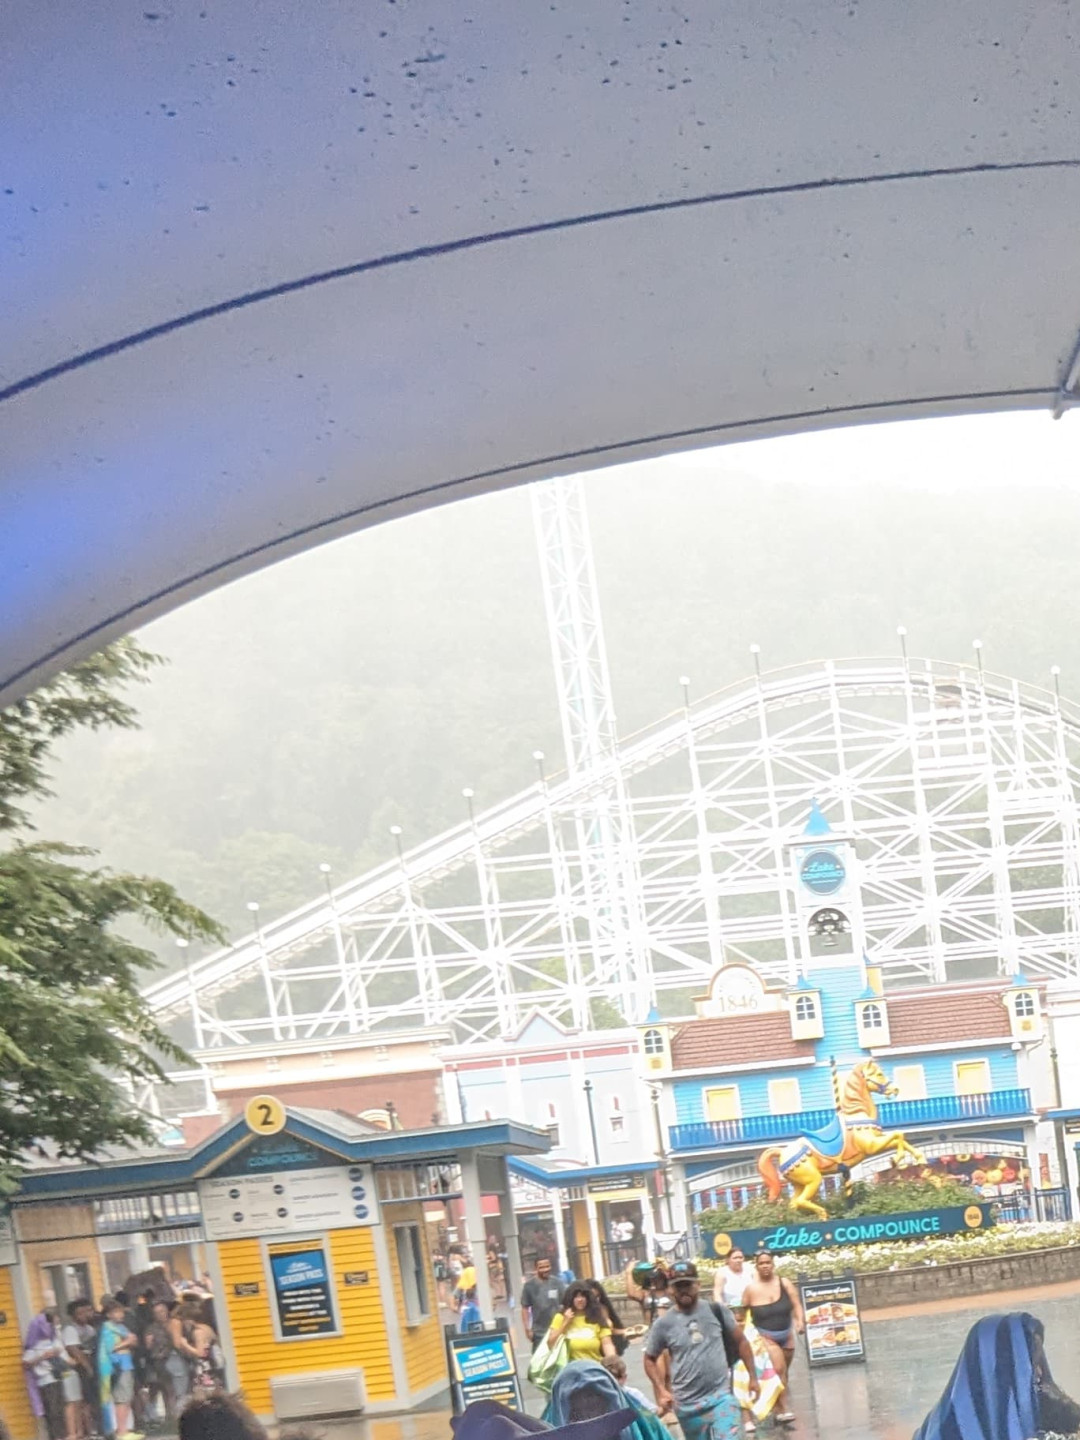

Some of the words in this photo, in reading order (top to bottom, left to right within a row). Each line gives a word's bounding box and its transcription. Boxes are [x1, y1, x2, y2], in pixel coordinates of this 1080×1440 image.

[719, 994, 758, 1012] 1846
[257, 1104, 275, 1126] 2
[762, 1226, 823, 1250] Lake
[834, 1216, 941, 1242] COMPOUNCE
